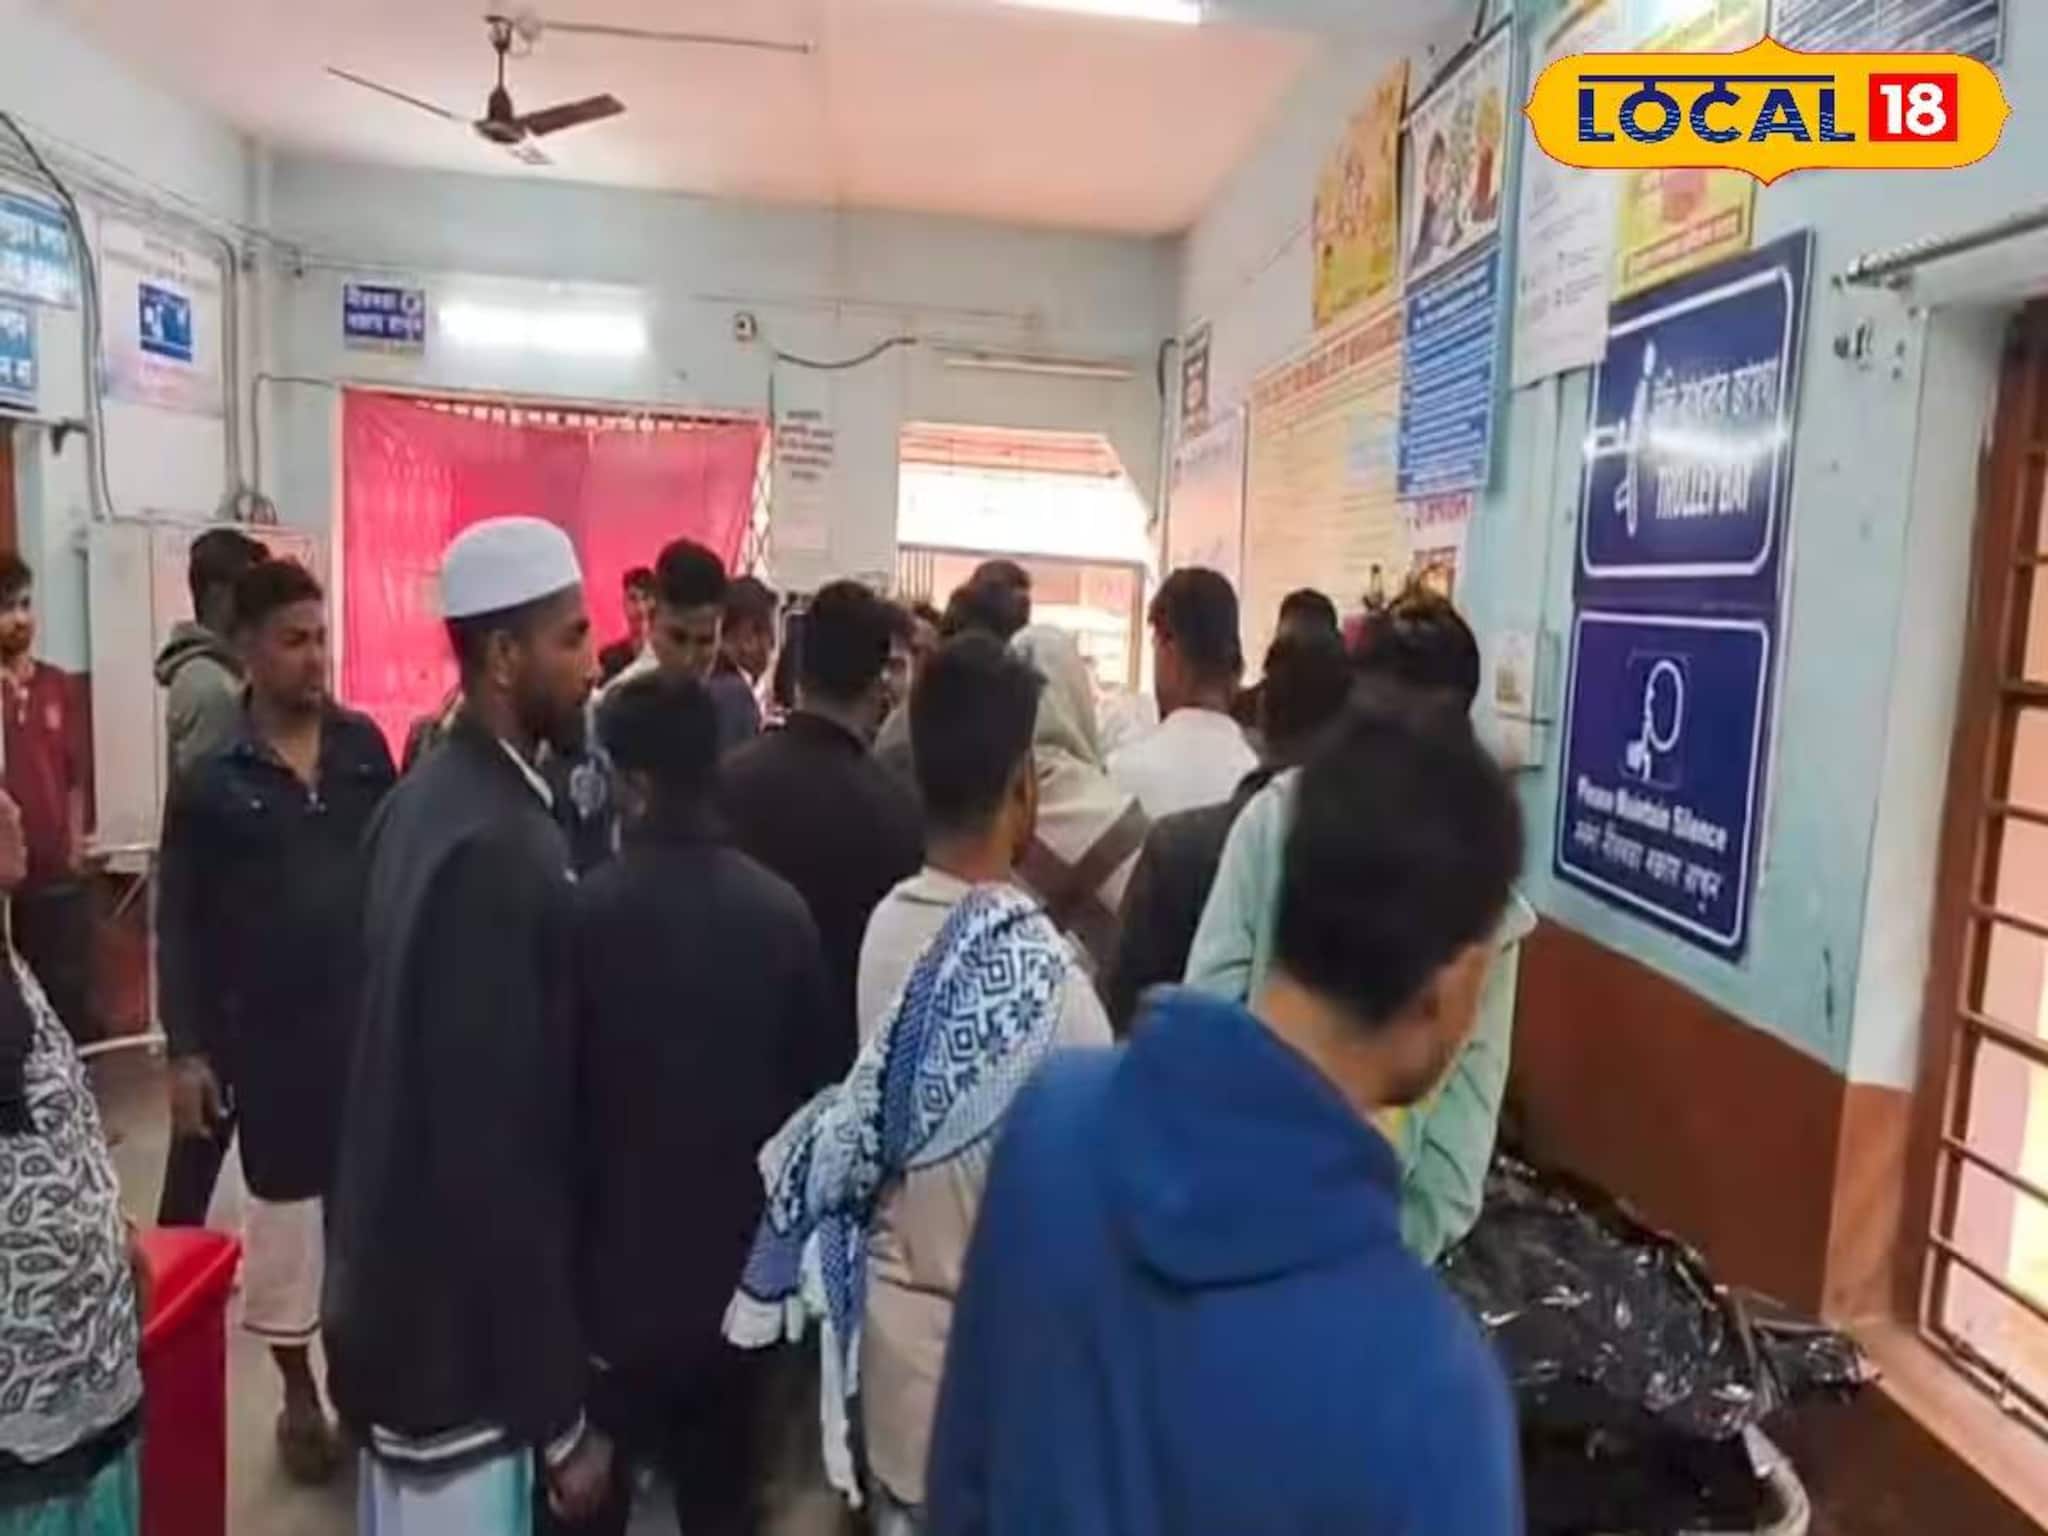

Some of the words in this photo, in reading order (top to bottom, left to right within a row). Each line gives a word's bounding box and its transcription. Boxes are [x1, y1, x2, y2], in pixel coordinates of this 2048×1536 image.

[1656, 464, 1716, 519] TROLLEY
[1718, 459, 1752, 513] BAY
[1673, 804, 1728, 853] Silence
